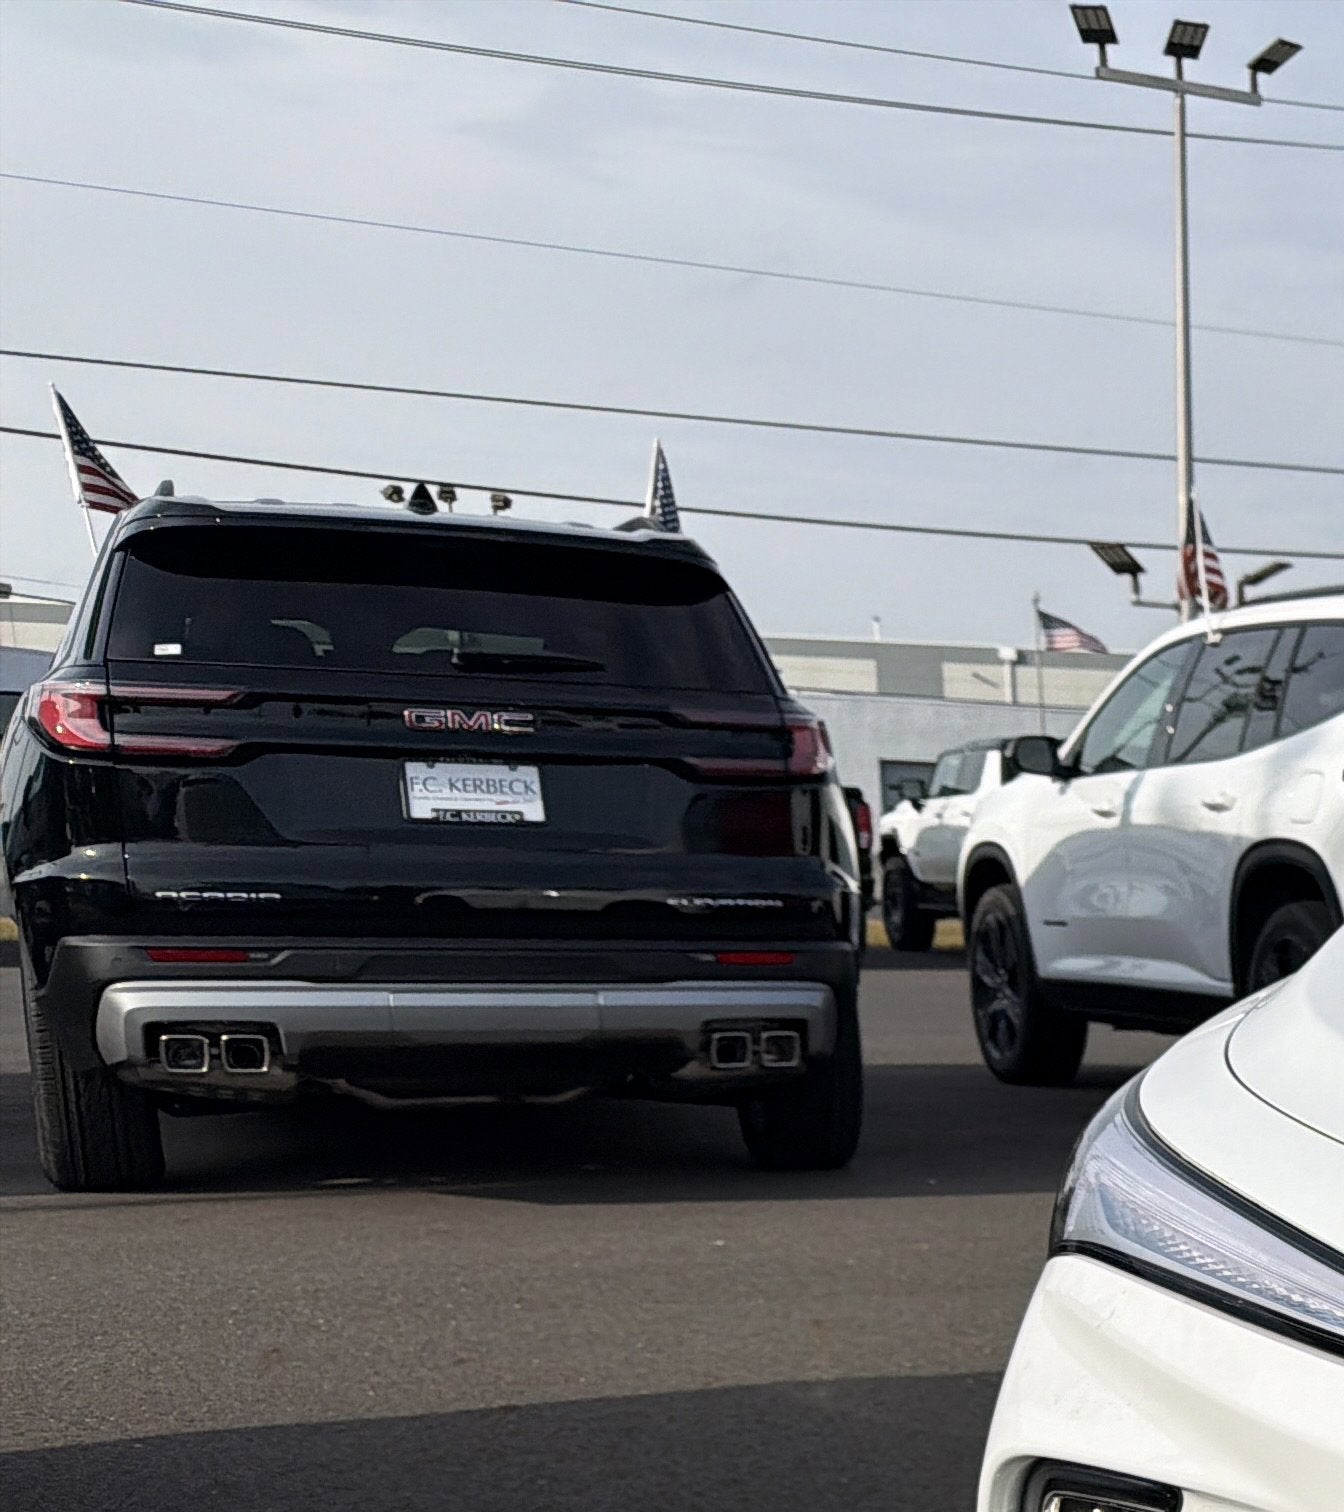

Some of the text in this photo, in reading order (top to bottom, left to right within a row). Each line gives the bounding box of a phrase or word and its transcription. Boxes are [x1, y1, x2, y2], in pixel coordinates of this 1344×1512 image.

[402, 707, 535, 734] GMC
[409, 776, 537, 796] F.C. KERBECK
